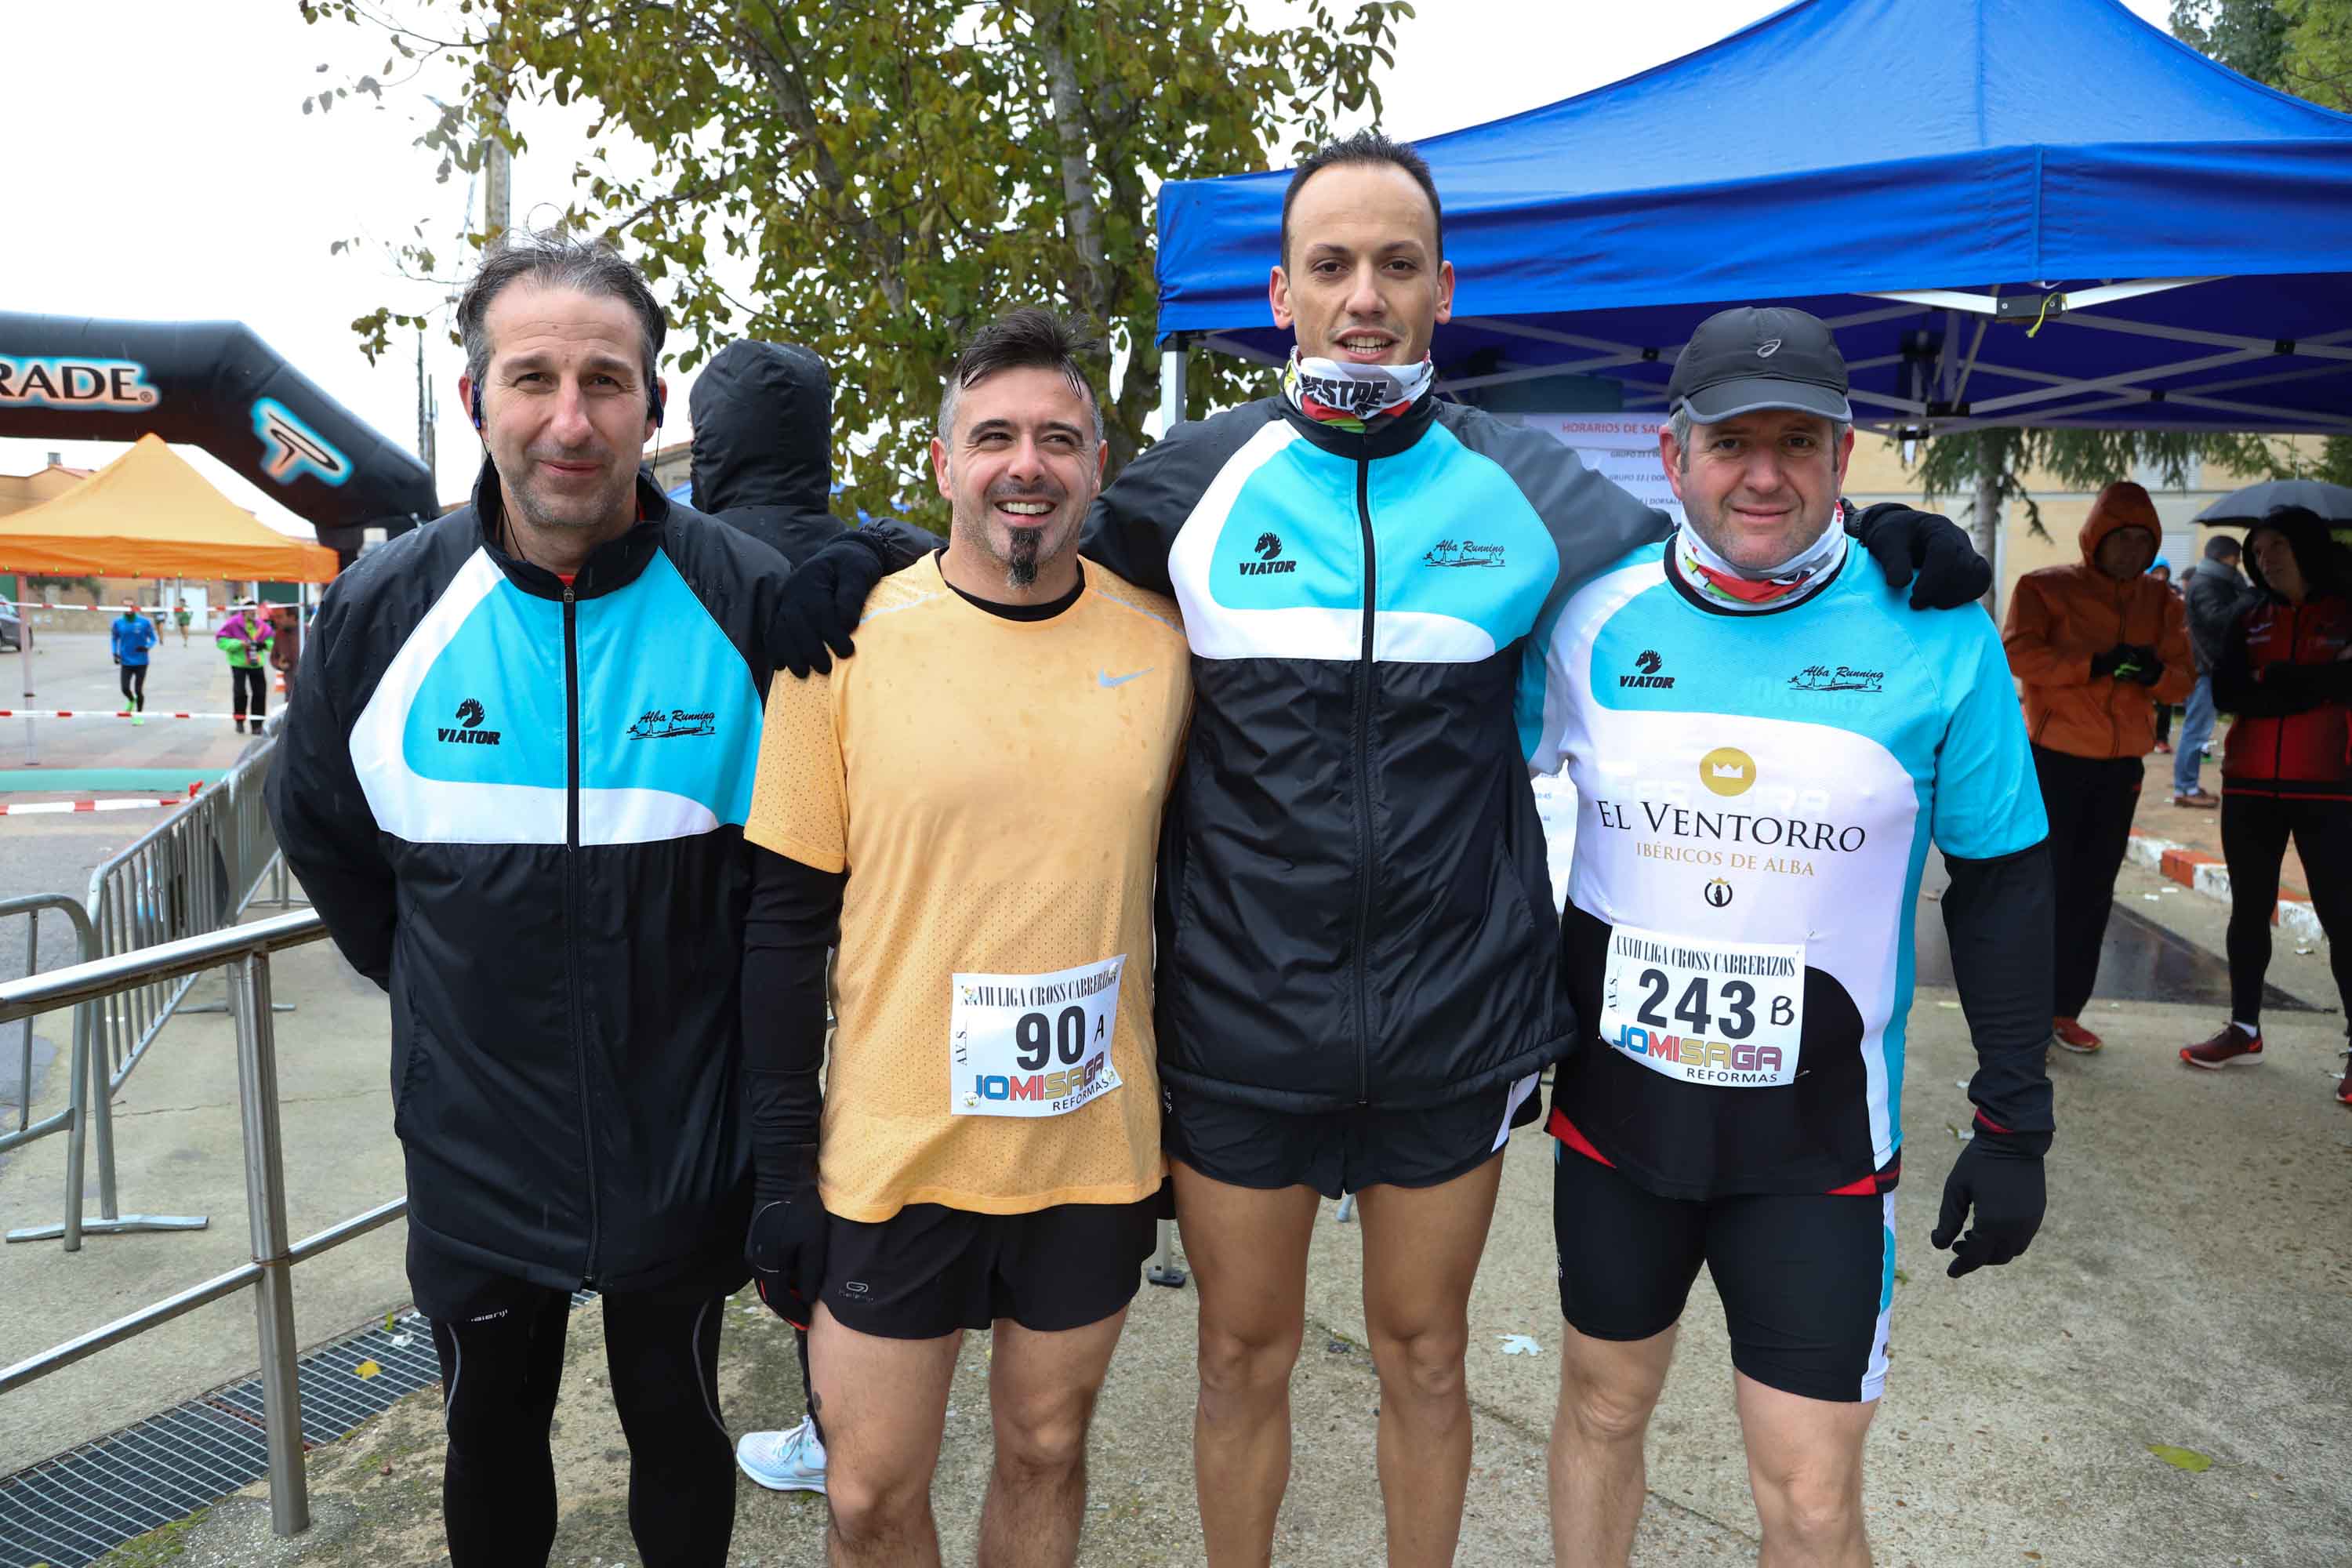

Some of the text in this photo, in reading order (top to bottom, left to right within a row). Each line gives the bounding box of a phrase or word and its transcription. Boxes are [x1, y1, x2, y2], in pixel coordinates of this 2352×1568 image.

[1562, 423, 1620, 434] HORARIOS
[1623, 423, 1638, 434] DE
[1432, 539, 1505, 554] Alba Running
[1239, 560, 1297, 575] VIATOR
[1619, 676, 1675, 689] VIATOR
[1799, 665, 1884, 680] Alba Running
[638, 710, 715, 724] Alba Running
[437, 728, 502, 746] VIATOR
[1595, 800, 1866, 853] EL VENTORRO
[1636, 840, 1815, 877] IBÉRICOS DE ALBA
[1643, 941, 1668, 966] LIGA
[1671, 946, 1711, 972] CROSS
[1714, 952, 1795, 978] CABRERIZOS
[997, 985, 1025, 1008] LIGA
[1029, 982, 1067, 1007] CROSS
[1636, 968, 1756, 1040] 243
[1769, 995, 1795, 1026] B
[1015, 1005, 1087, 1071] 90
[1094, 1013, 1105, 1042] A
[1612, 1024, 1783, 1072] JOMISAGA
[1686, 1067, 1778, 1083] REFORMAS
[1052, 1079, 1110, 1112] REFORMAS
